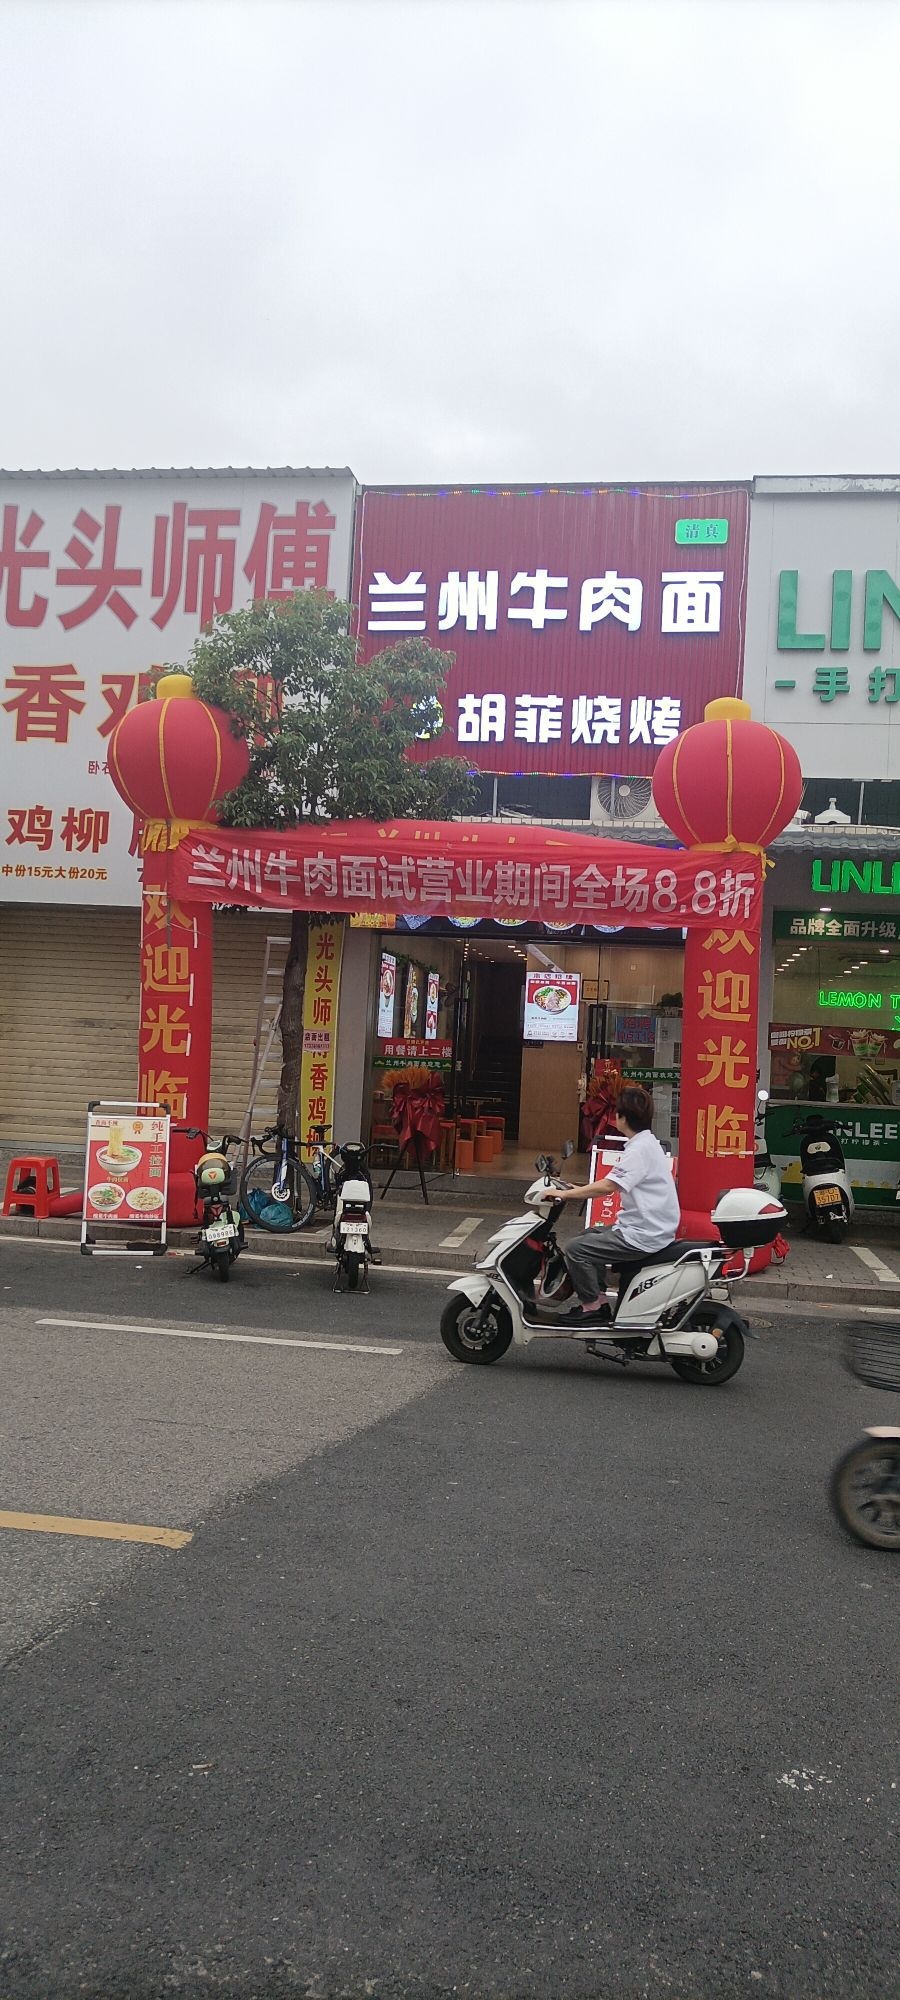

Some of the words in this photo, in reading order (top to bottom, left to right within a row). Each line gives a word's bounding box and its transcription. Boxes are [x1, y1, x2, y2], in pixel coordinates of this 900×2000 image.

[685, 524, 718, 538] 清真
[0, 499, 336, 634] 光头师傅
[367, 569, 724, 633] 兰州牛肉面
[457, 693, 681, 745] 胡菲烧烤
[5, 804, 110, 853] 鸡柳
[1, 864, 108, 880] 中份15元大份20元
[187, 844, 756, 919] 兰州牛肉面试营业期间全场8.8折
[142, 884, 193, 1119] 欢迎光临
[819, 991, 881, 1008] LEMON
[384, 1044, 452, 1058] 用餐请上二楼
